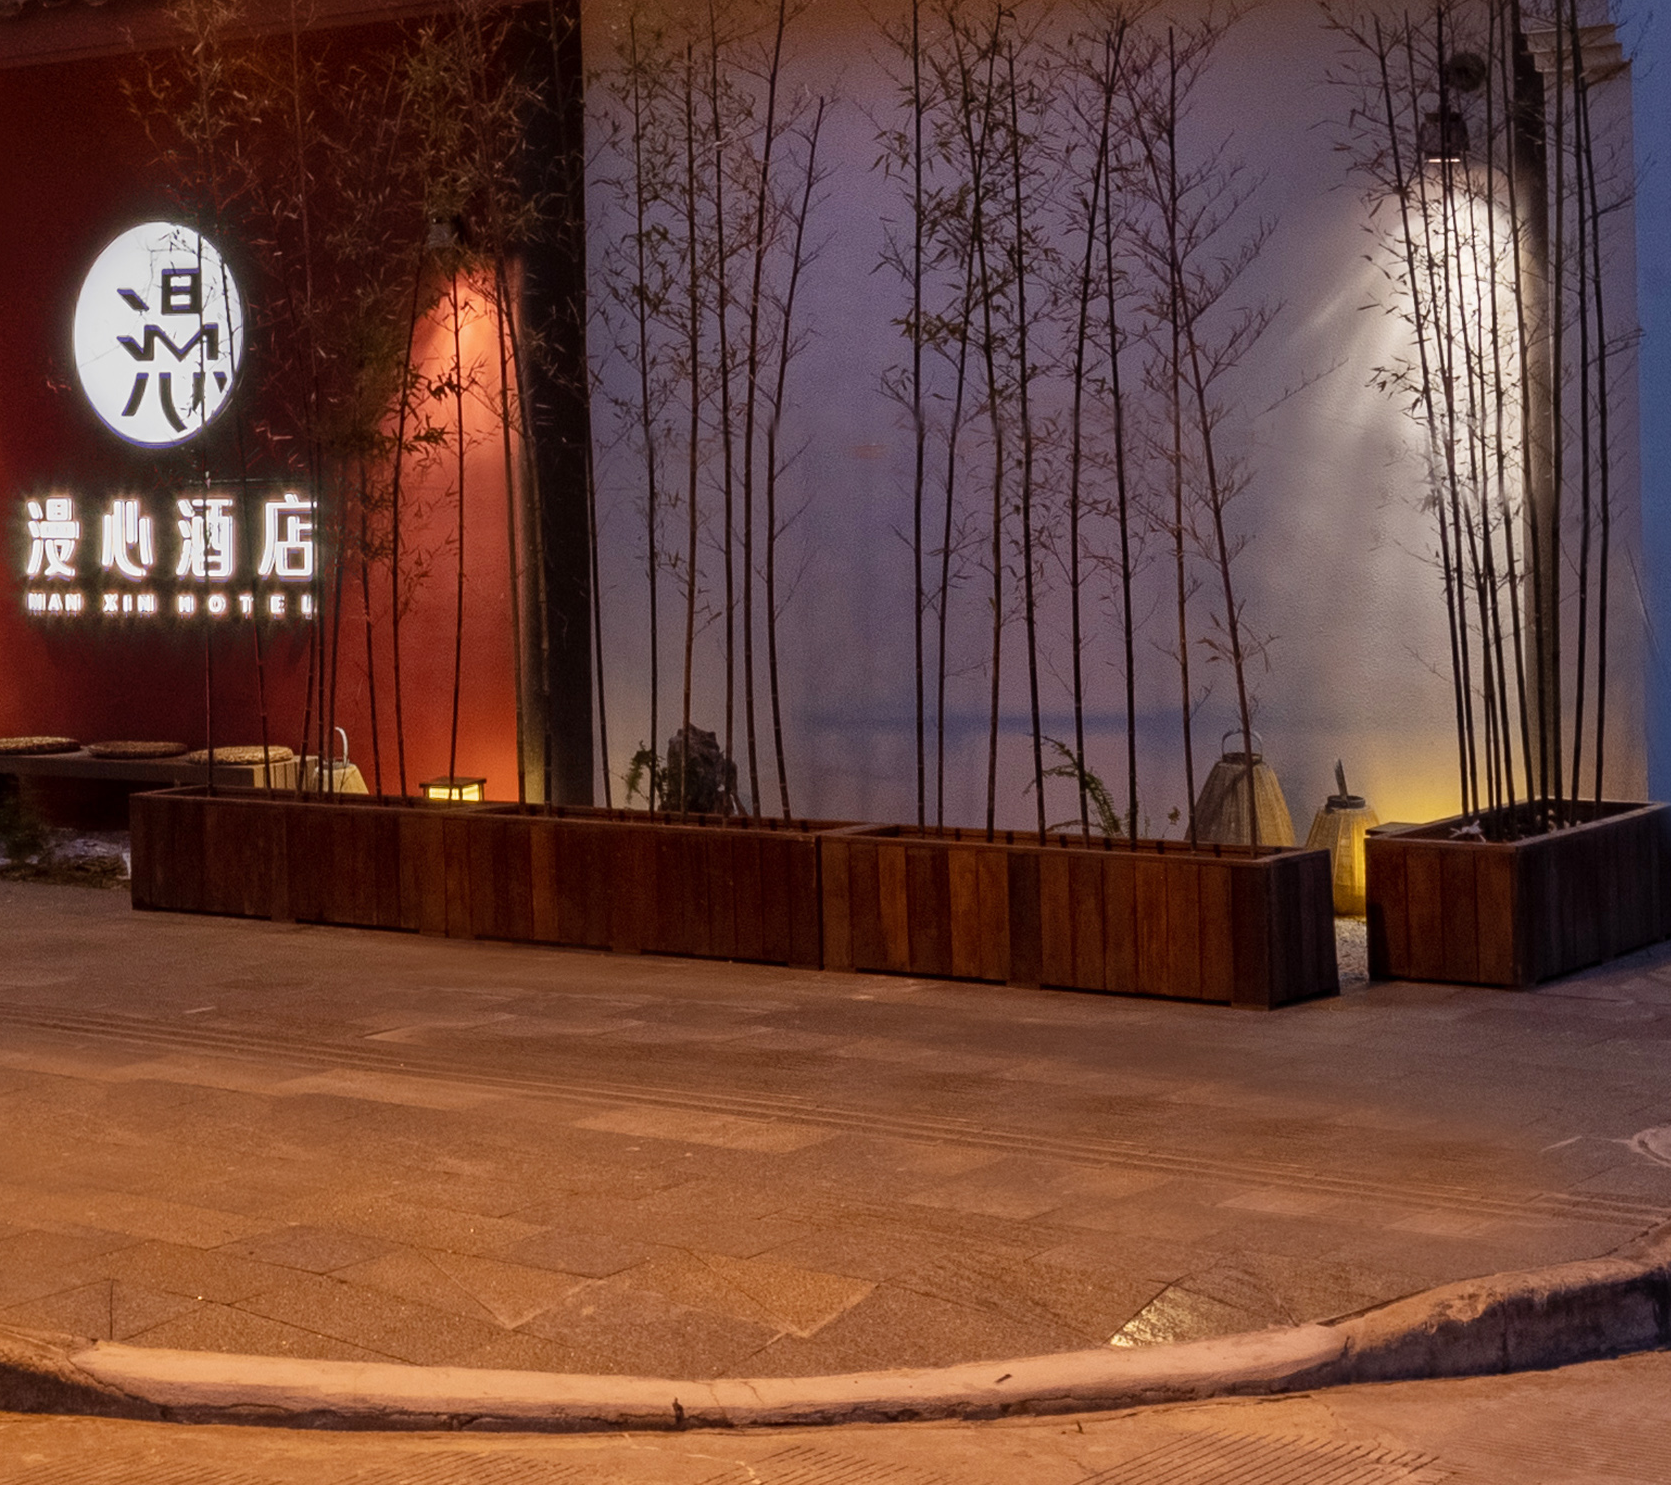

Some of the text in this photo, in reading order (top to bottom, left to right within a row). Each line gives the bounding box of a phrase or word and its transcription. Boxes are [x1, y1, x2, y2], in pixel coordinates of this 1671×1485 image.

[26, 492, 317, 582] 漫心酒店
[27, 592, 317, 616] MAN XIN HOTEL
